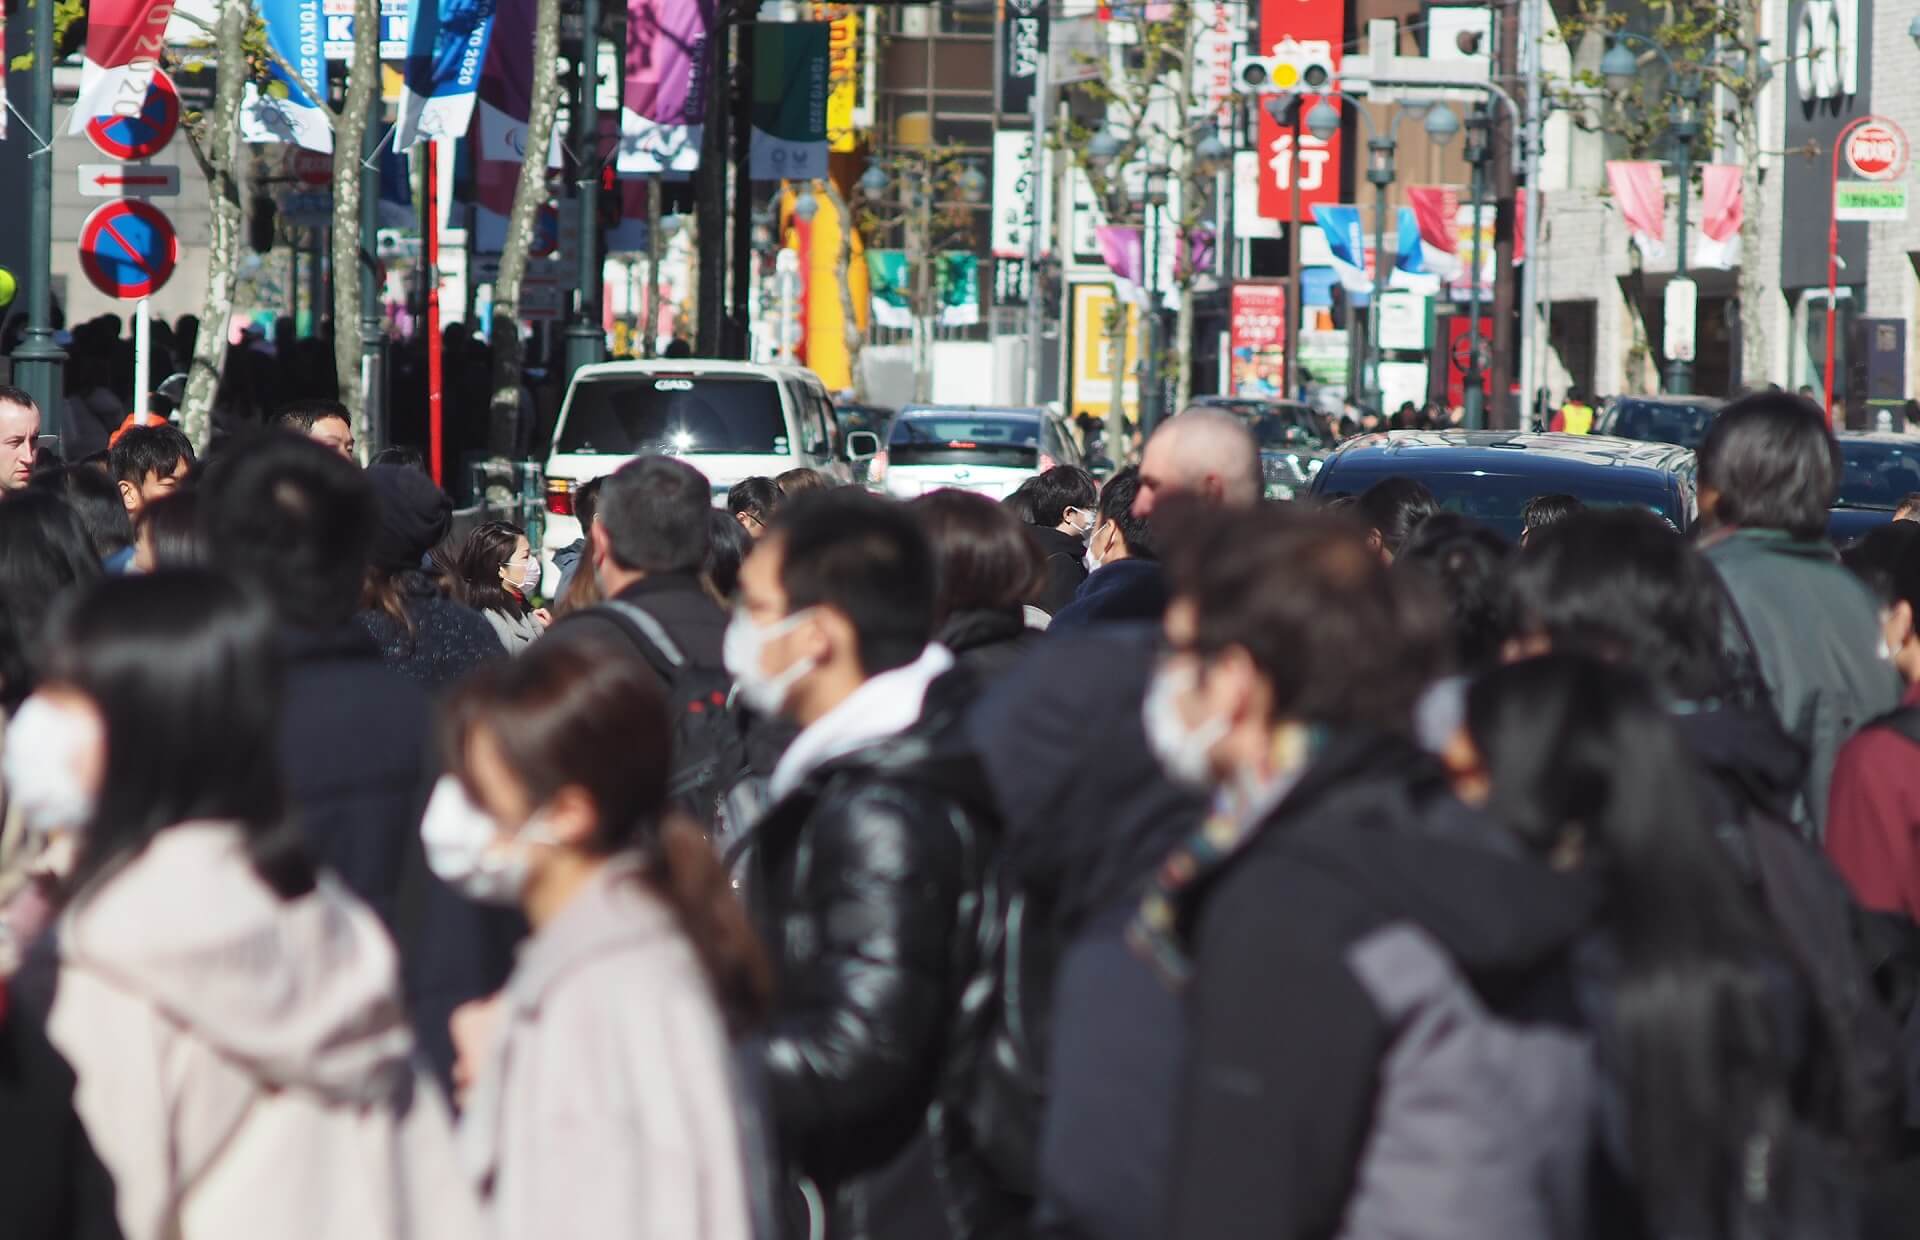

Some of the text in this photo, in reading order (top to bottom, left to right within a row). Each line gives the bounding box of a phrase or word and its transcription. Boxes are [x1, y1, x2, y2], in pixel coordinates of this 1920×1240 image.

[299, 0, 320, 56] TOKYO
[112, 34, 164, 116] 2020
[457, 47, 481, 86] 2020
